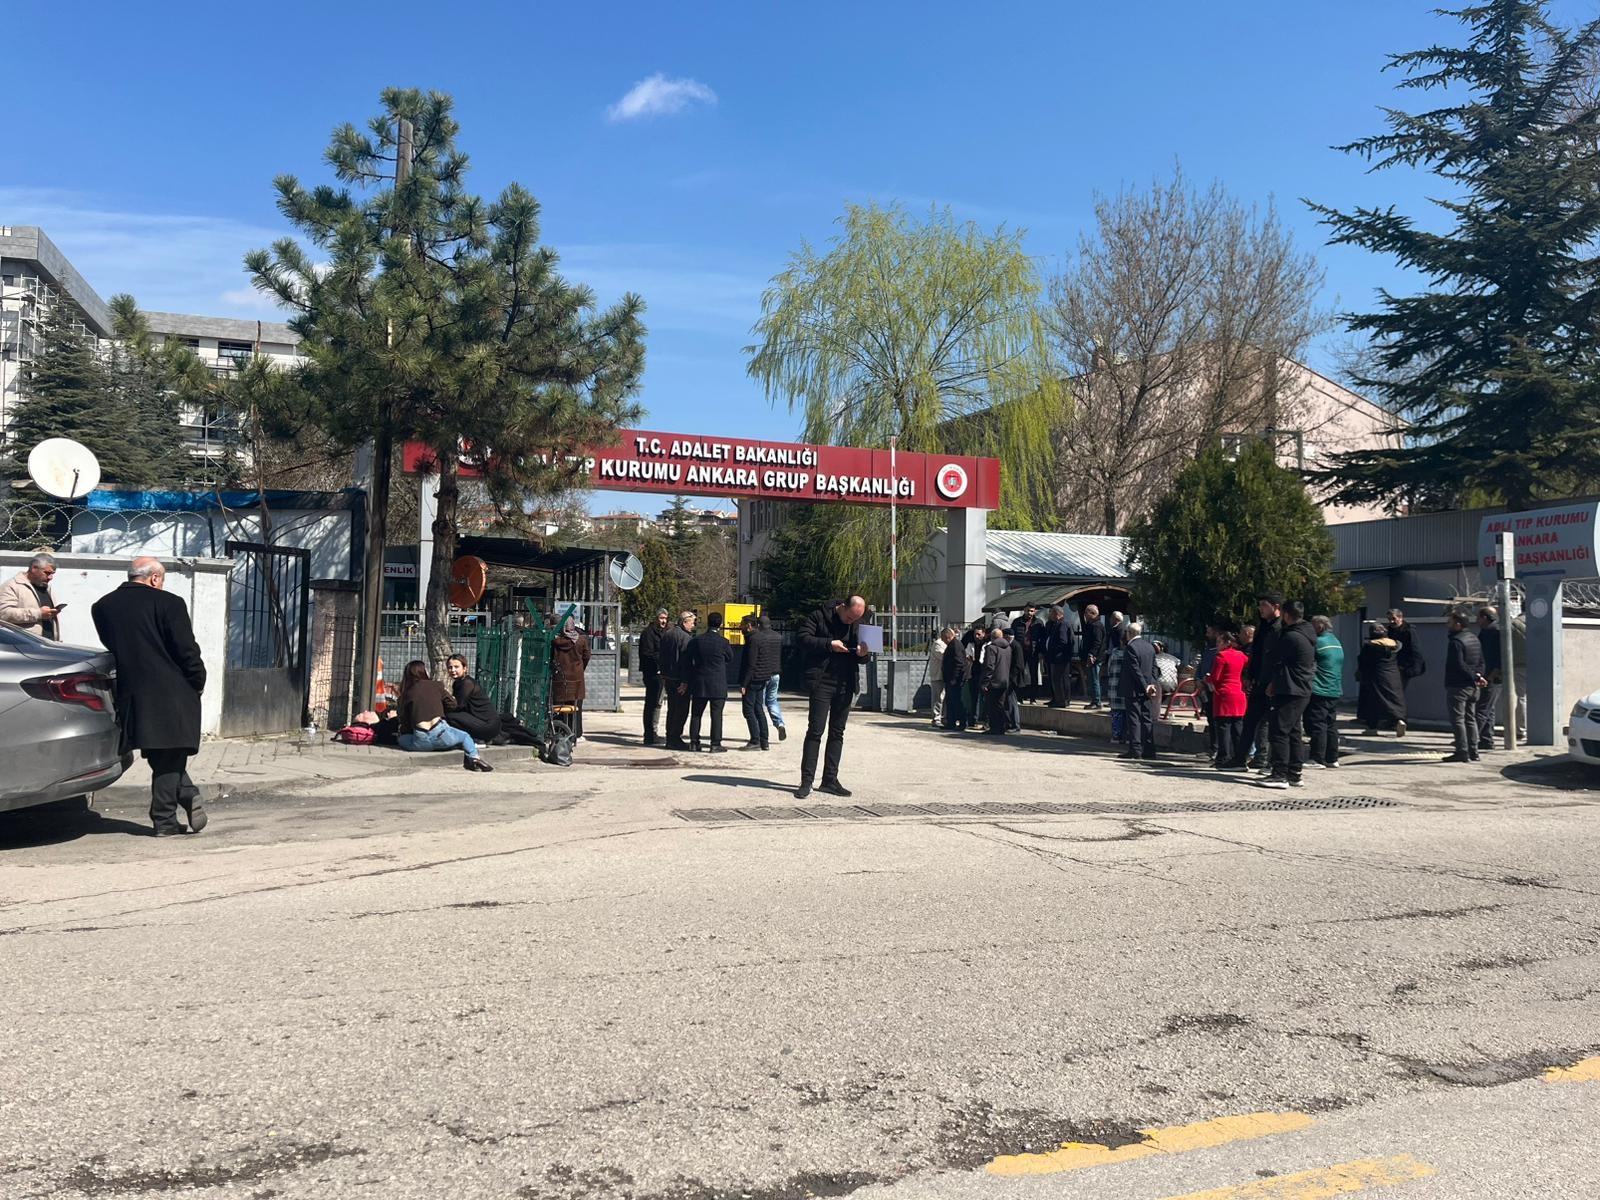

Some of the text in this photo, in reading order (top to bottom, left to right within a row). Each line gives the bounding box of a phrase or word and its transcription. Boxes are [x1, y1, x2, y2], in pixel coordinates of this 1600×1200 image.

[636, 437, 817, 466] T.C. ADALET BAKANLIĞI
[601, 459, 681, 481] KURUMU
[686, 465, 758, 486] ANKARA
[764, 471, 809, 489] GRUP
[816, 475, 915, 496] BAŞKANLIĞI
[1536, 512, 1590, 528] KURUMU
[1513, 532, 1558, 547] NKARA
[1517, 545, 1590, 566] BAŞKANLIĞI
